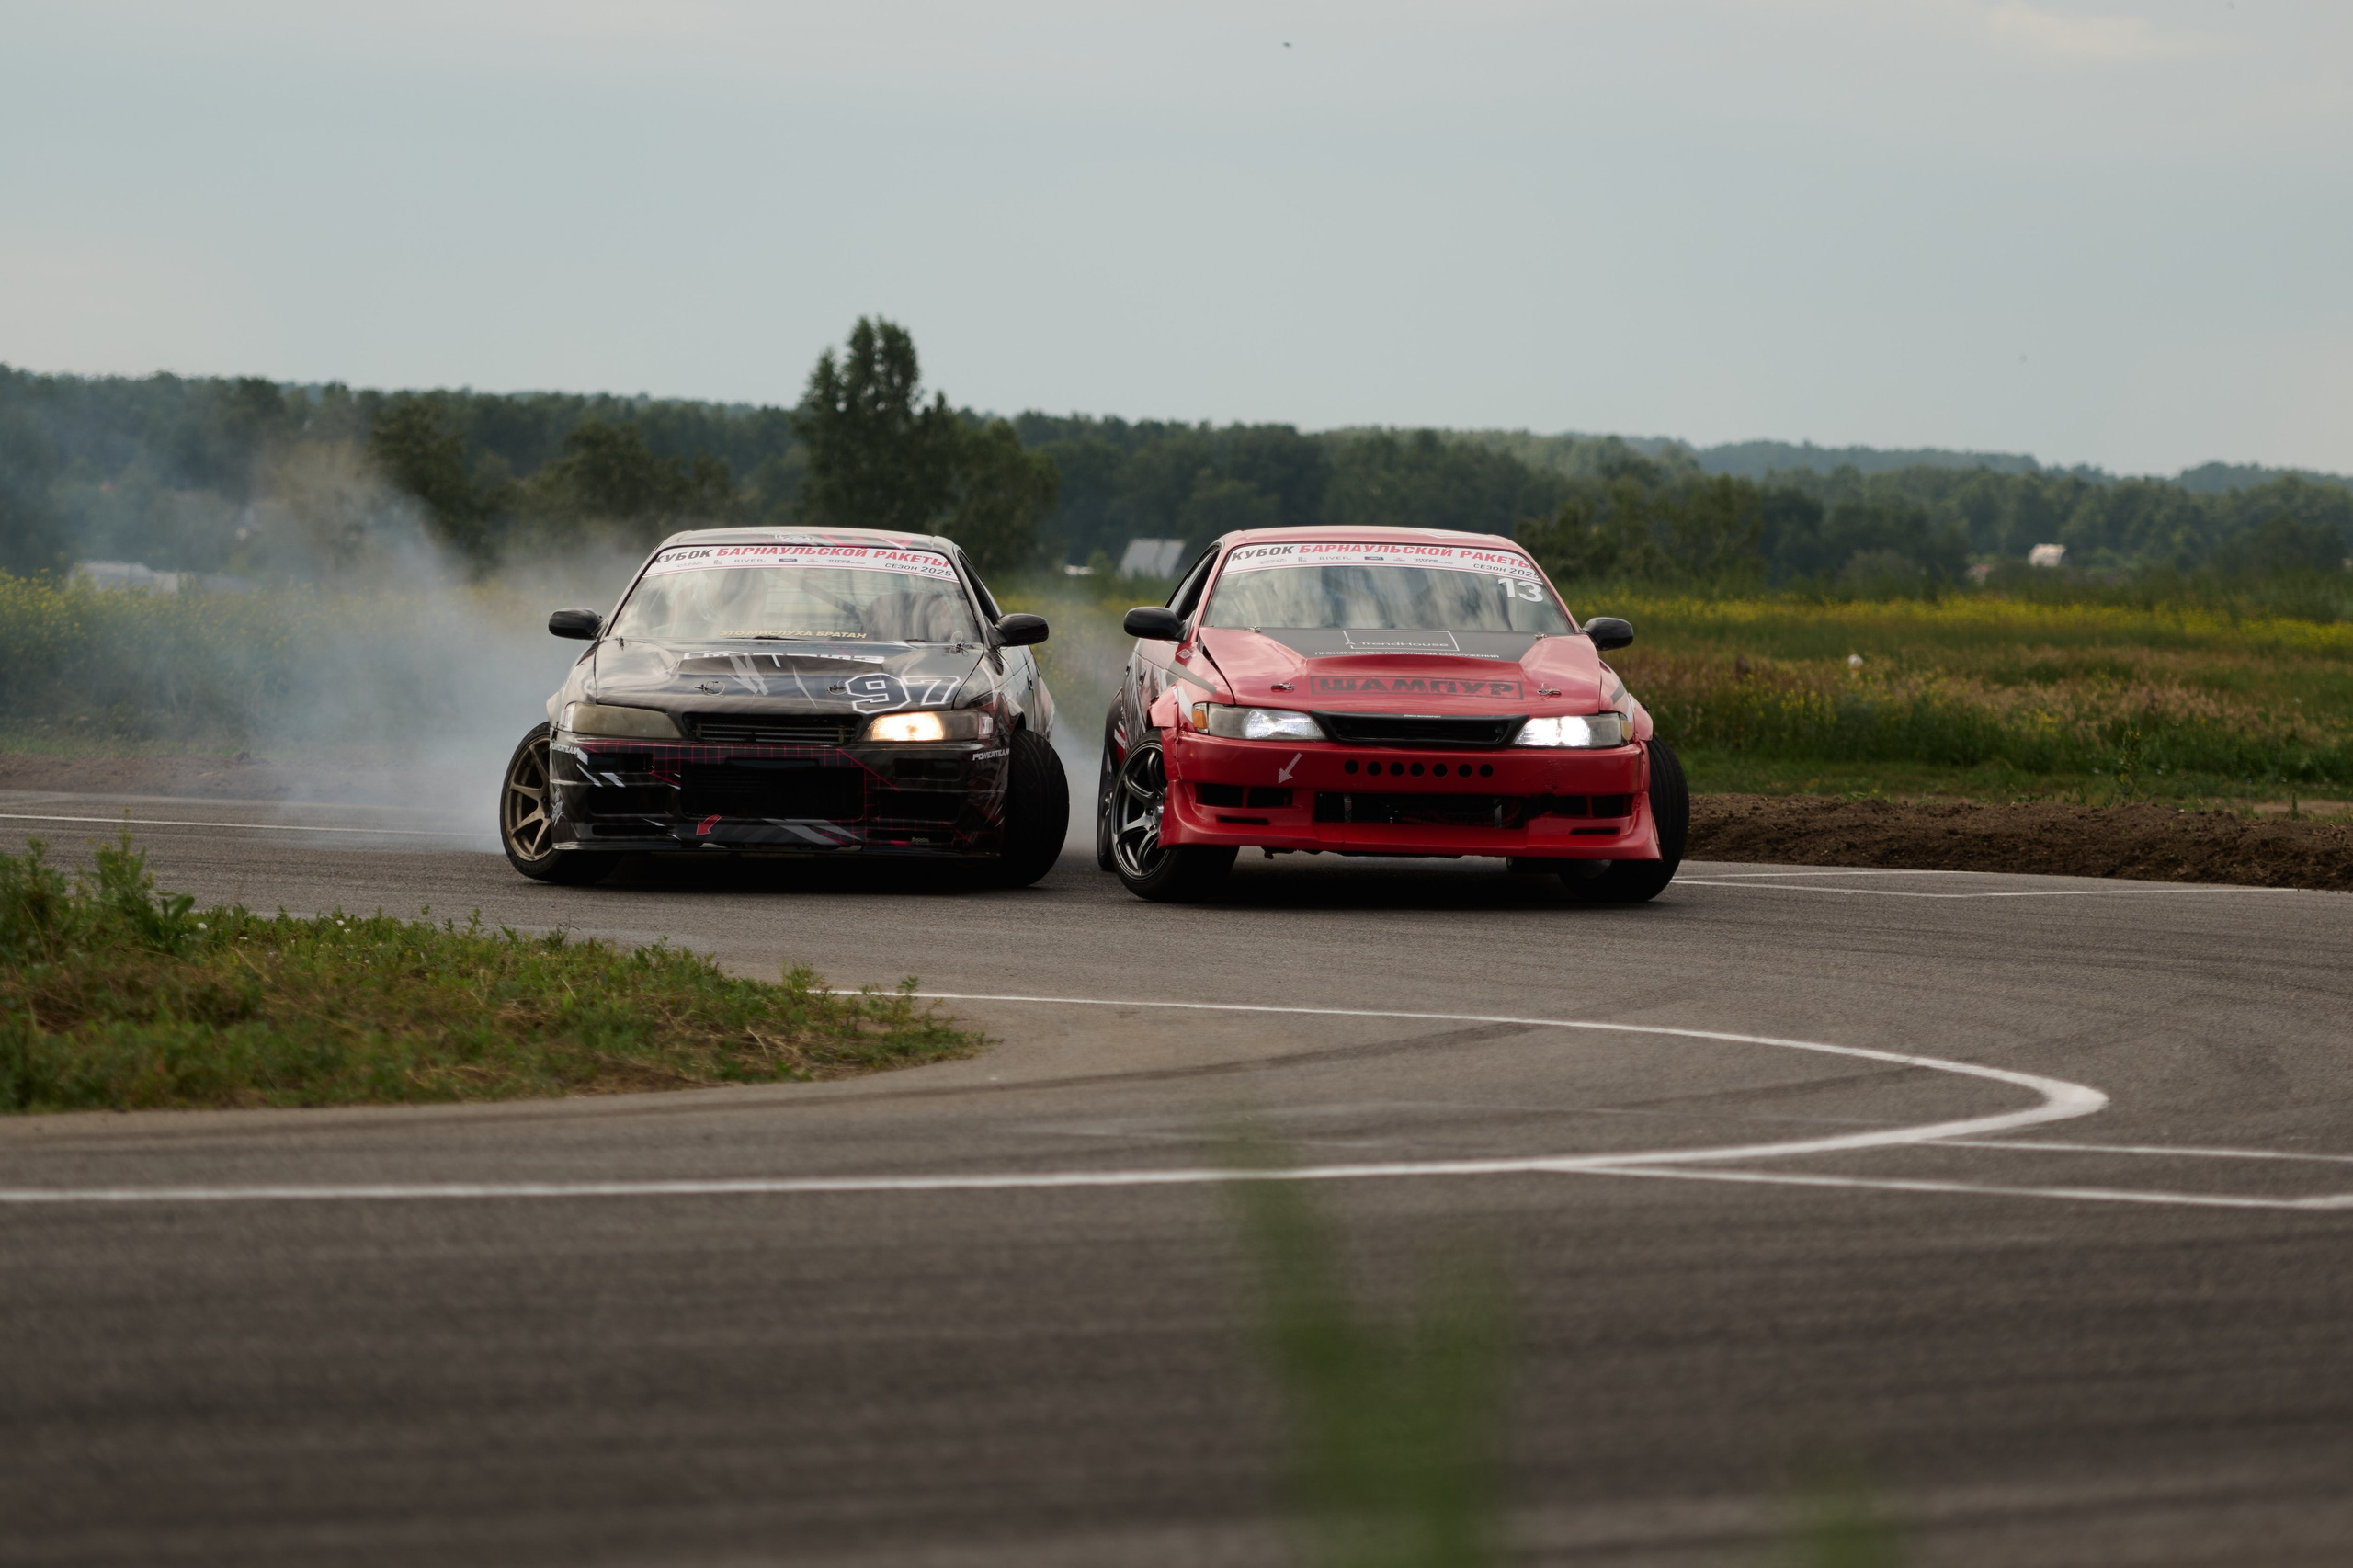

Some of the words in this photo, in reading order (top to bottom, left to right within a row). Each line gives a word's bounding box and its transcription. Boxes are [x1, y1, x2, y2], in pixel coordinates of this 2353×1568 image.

[652, 549, 713, 563] КУБОК
[716, 545, 868, 558] БАРНАУЛЬСКОЙ
[872, 551, 950, 568] РАКЕТЫ
[1231, 546, 1295, 562] КУБОК
[1299, 544, 1454, 557] БАРНАУЛЬСКОЙ
[884, 562, 918, 572] СЕЗОН
[920, 565, 953, 577] 2025
[1472, 563, 1506, 572] СЕЗОН
[1497, 577, 1543, 602] 13
[845, 672, 961, 714] 97
[1319, 678, 1515, 696] ШАМПУР
